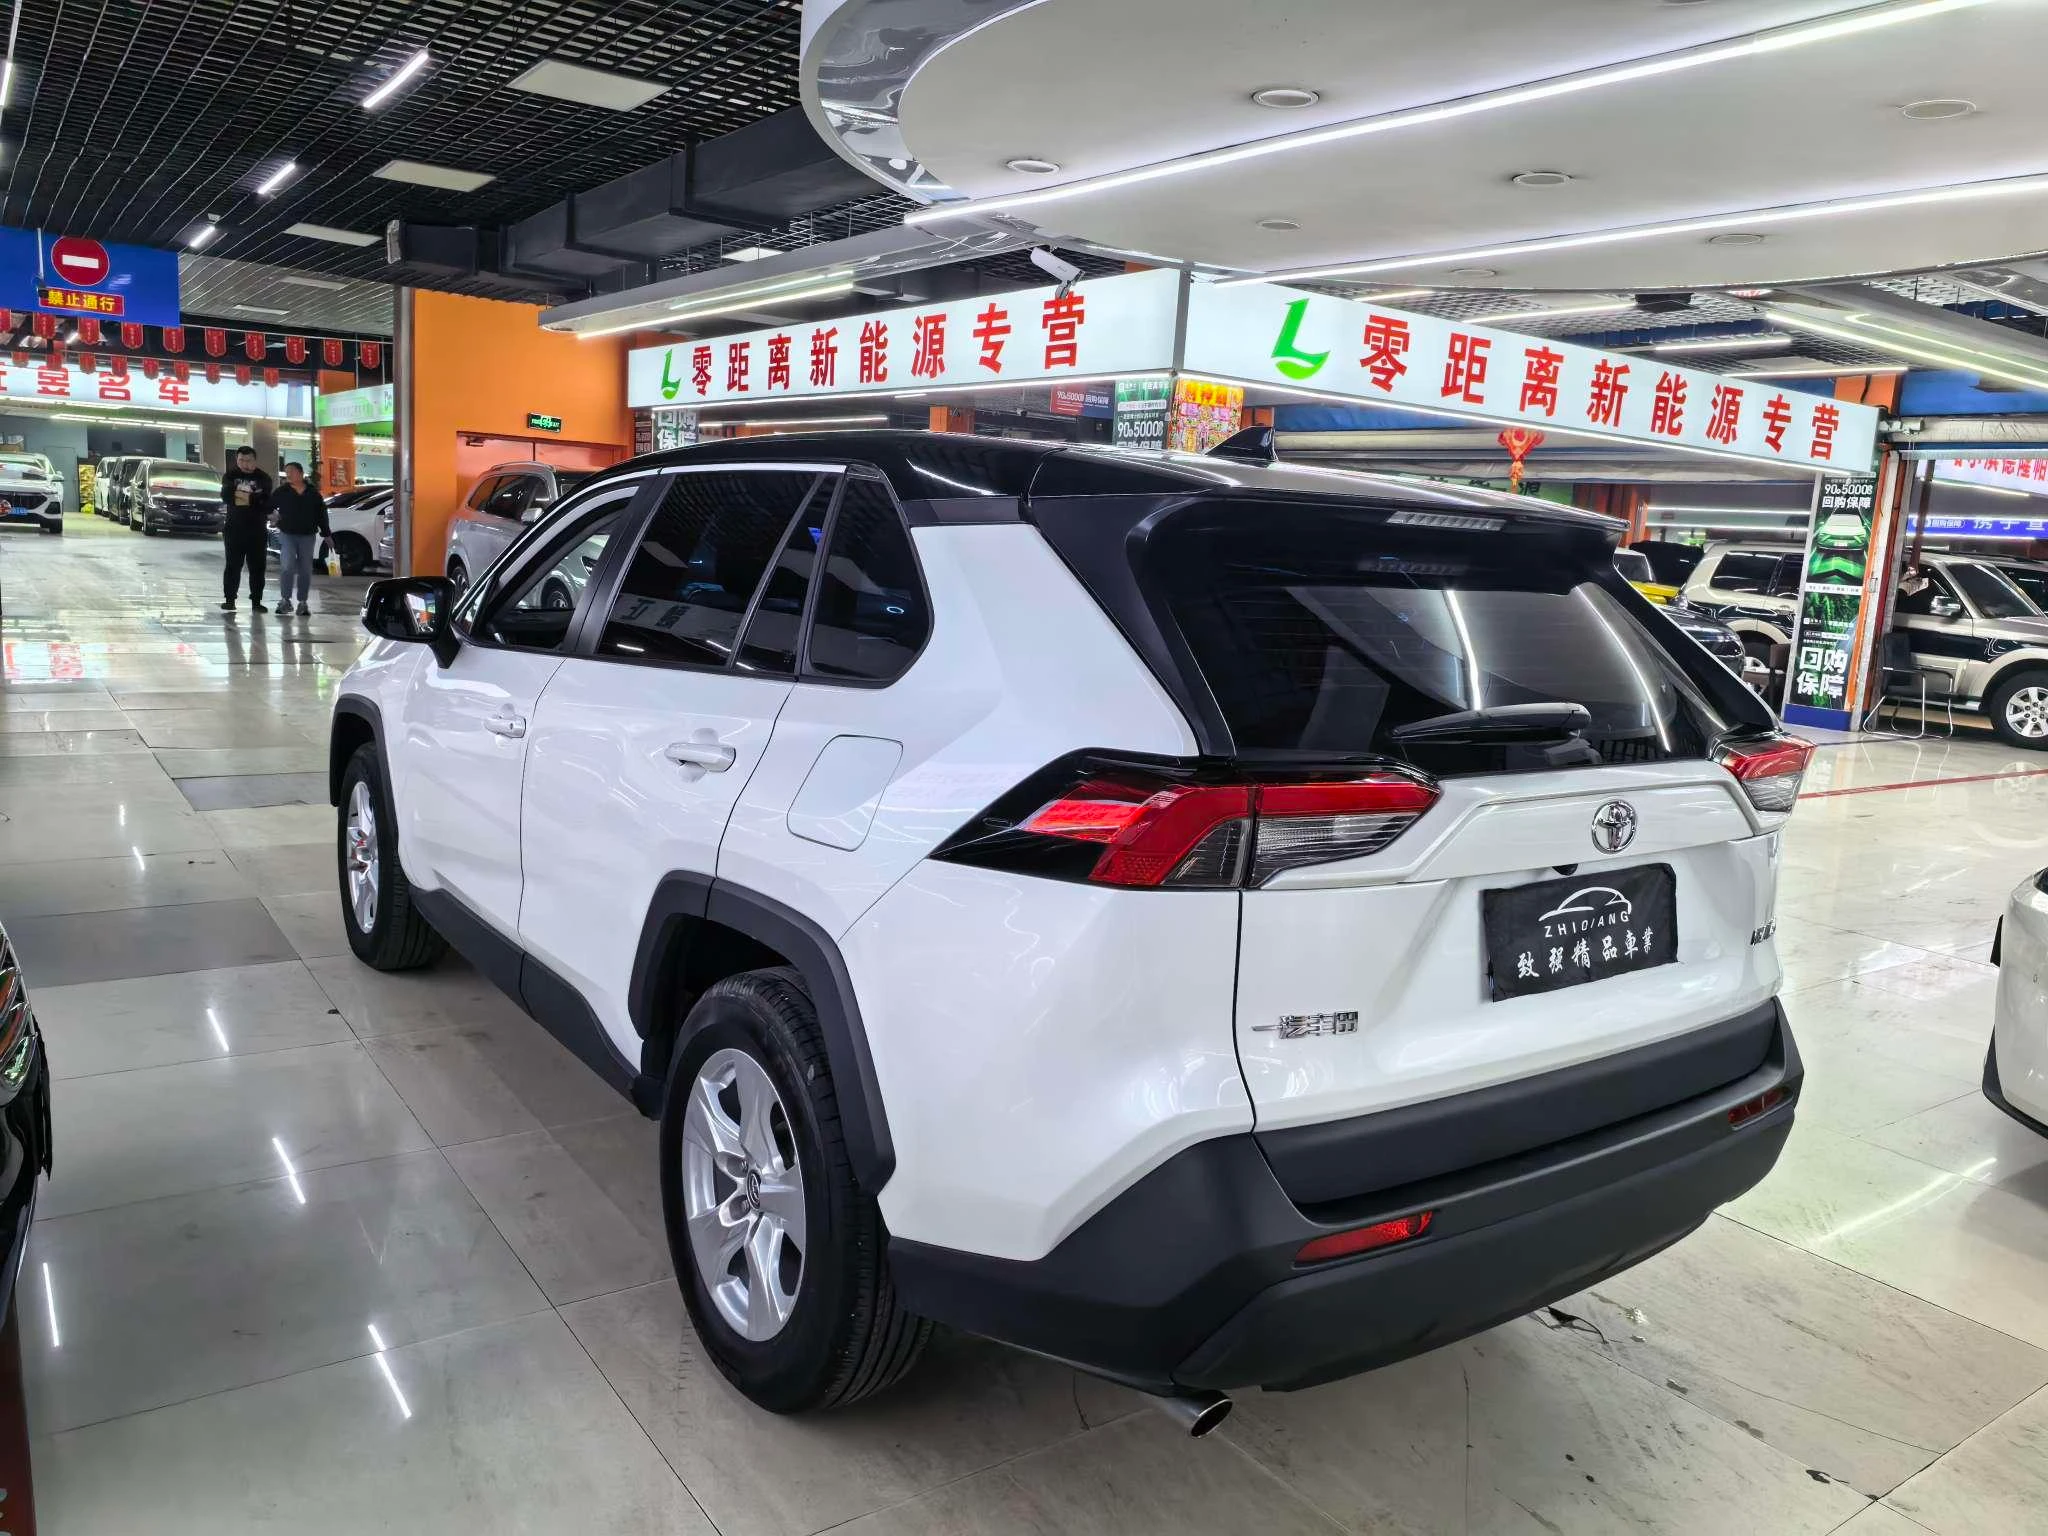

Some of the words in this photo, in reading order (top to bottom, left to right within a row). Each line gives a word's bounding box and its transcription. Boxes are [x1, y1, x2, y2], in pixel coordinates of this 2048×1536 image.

[48, 290, 116, 312] 禁止通行
[692, 291, 1084, 396] 零距离新能源专营
[1360, 315, 1840, 460] 零距离新能源专营
[1822, 496, 1871, 509] 回购保障
[1799, 646, 1849, 674] 回购
[1797, 671, 1845, 698] 保障
